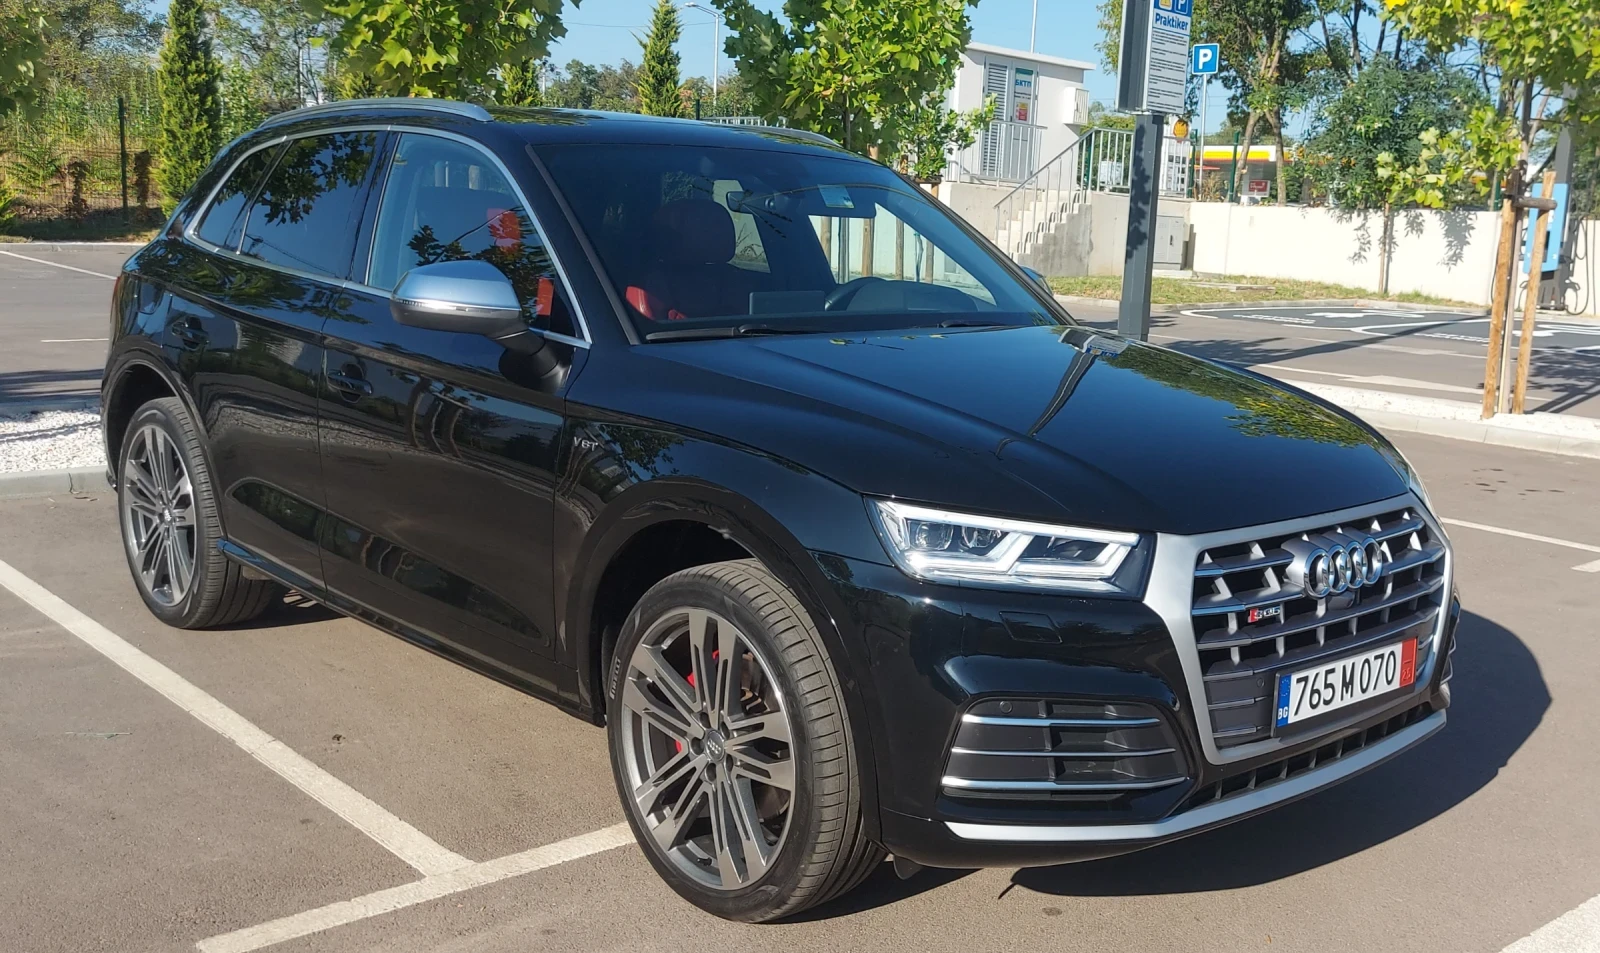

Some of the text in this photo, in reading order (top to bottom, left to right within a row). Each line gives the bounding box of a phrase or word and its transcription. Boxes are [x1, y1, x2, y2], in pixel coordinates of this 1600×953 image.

[1155, 12, 1189, 31] Praktiker
[1198, 48, 1213, 70] P
[1277, 706, 1289, 720] BG
